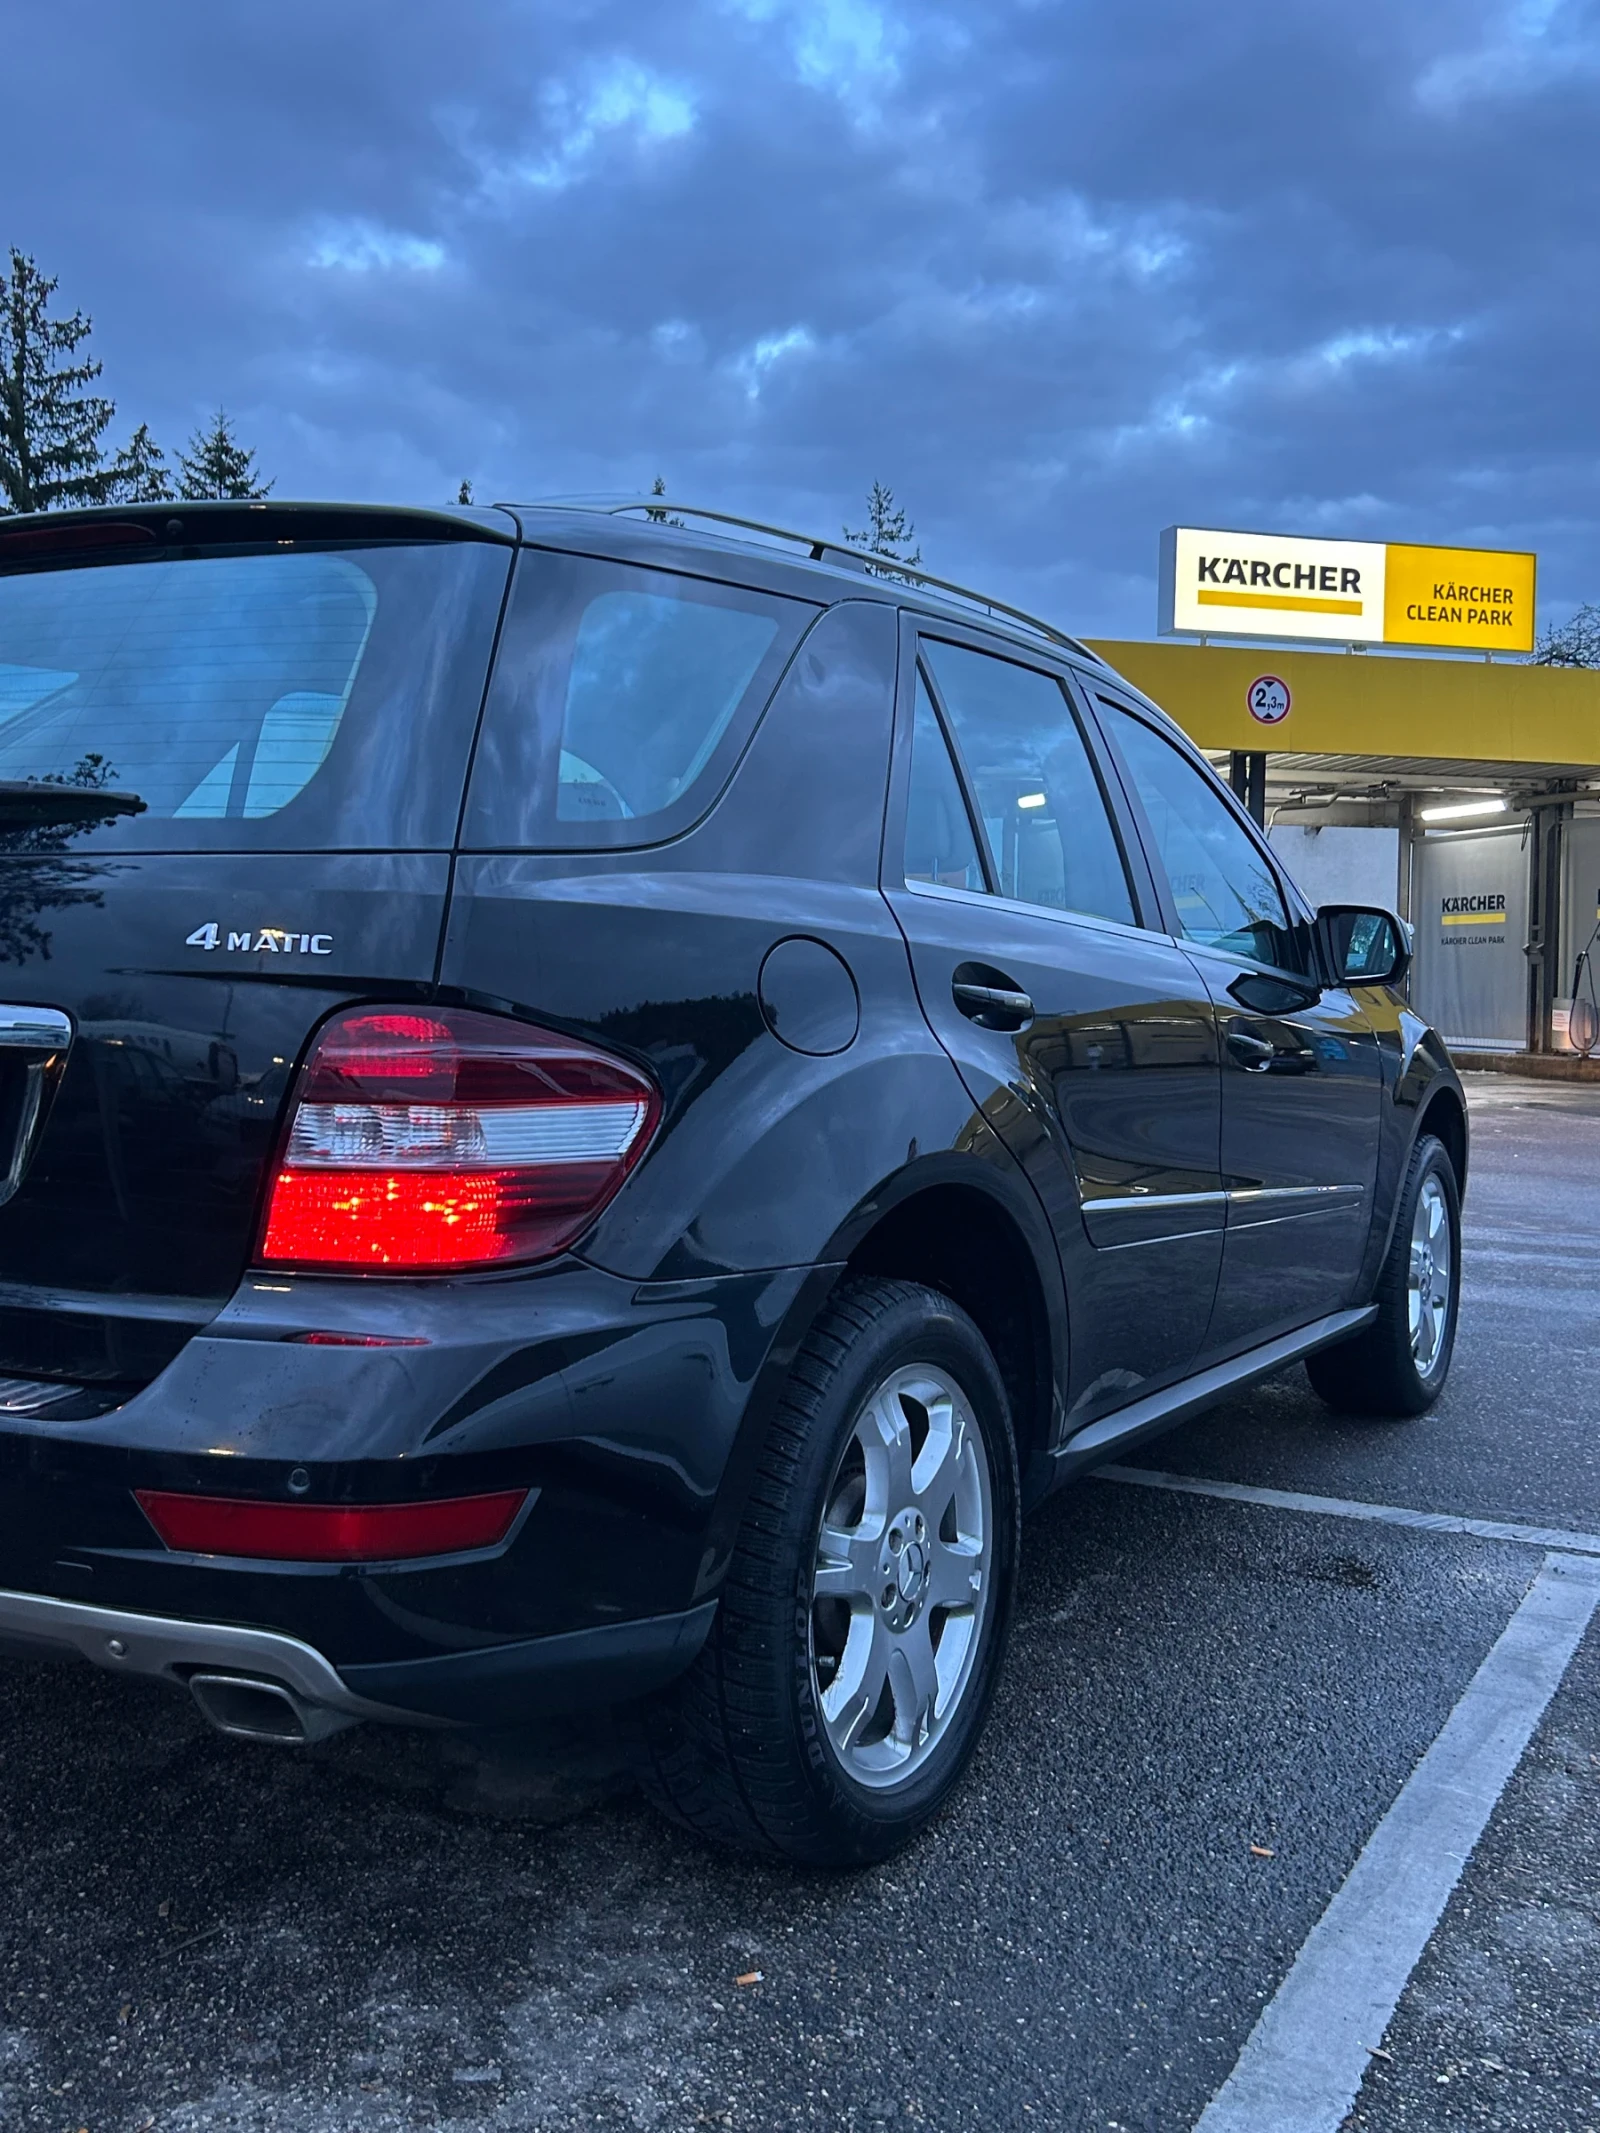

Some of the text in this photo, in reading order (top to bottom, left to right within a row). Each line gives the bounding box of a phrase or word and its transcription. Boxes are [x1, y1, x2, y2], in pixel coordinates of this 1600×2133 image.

[1198, 556, 1361, 594] KÄRCHER
[1433, 581, 1513, 605] KÄRCHER
[1406, 604, 1513, 626] CLEAN PARK
[1442, 894, 1505, 913] KÄRCHER
[1488, 935, 1505, 944] PARK
[795, 1567, 827, 1770] DUNLOP
